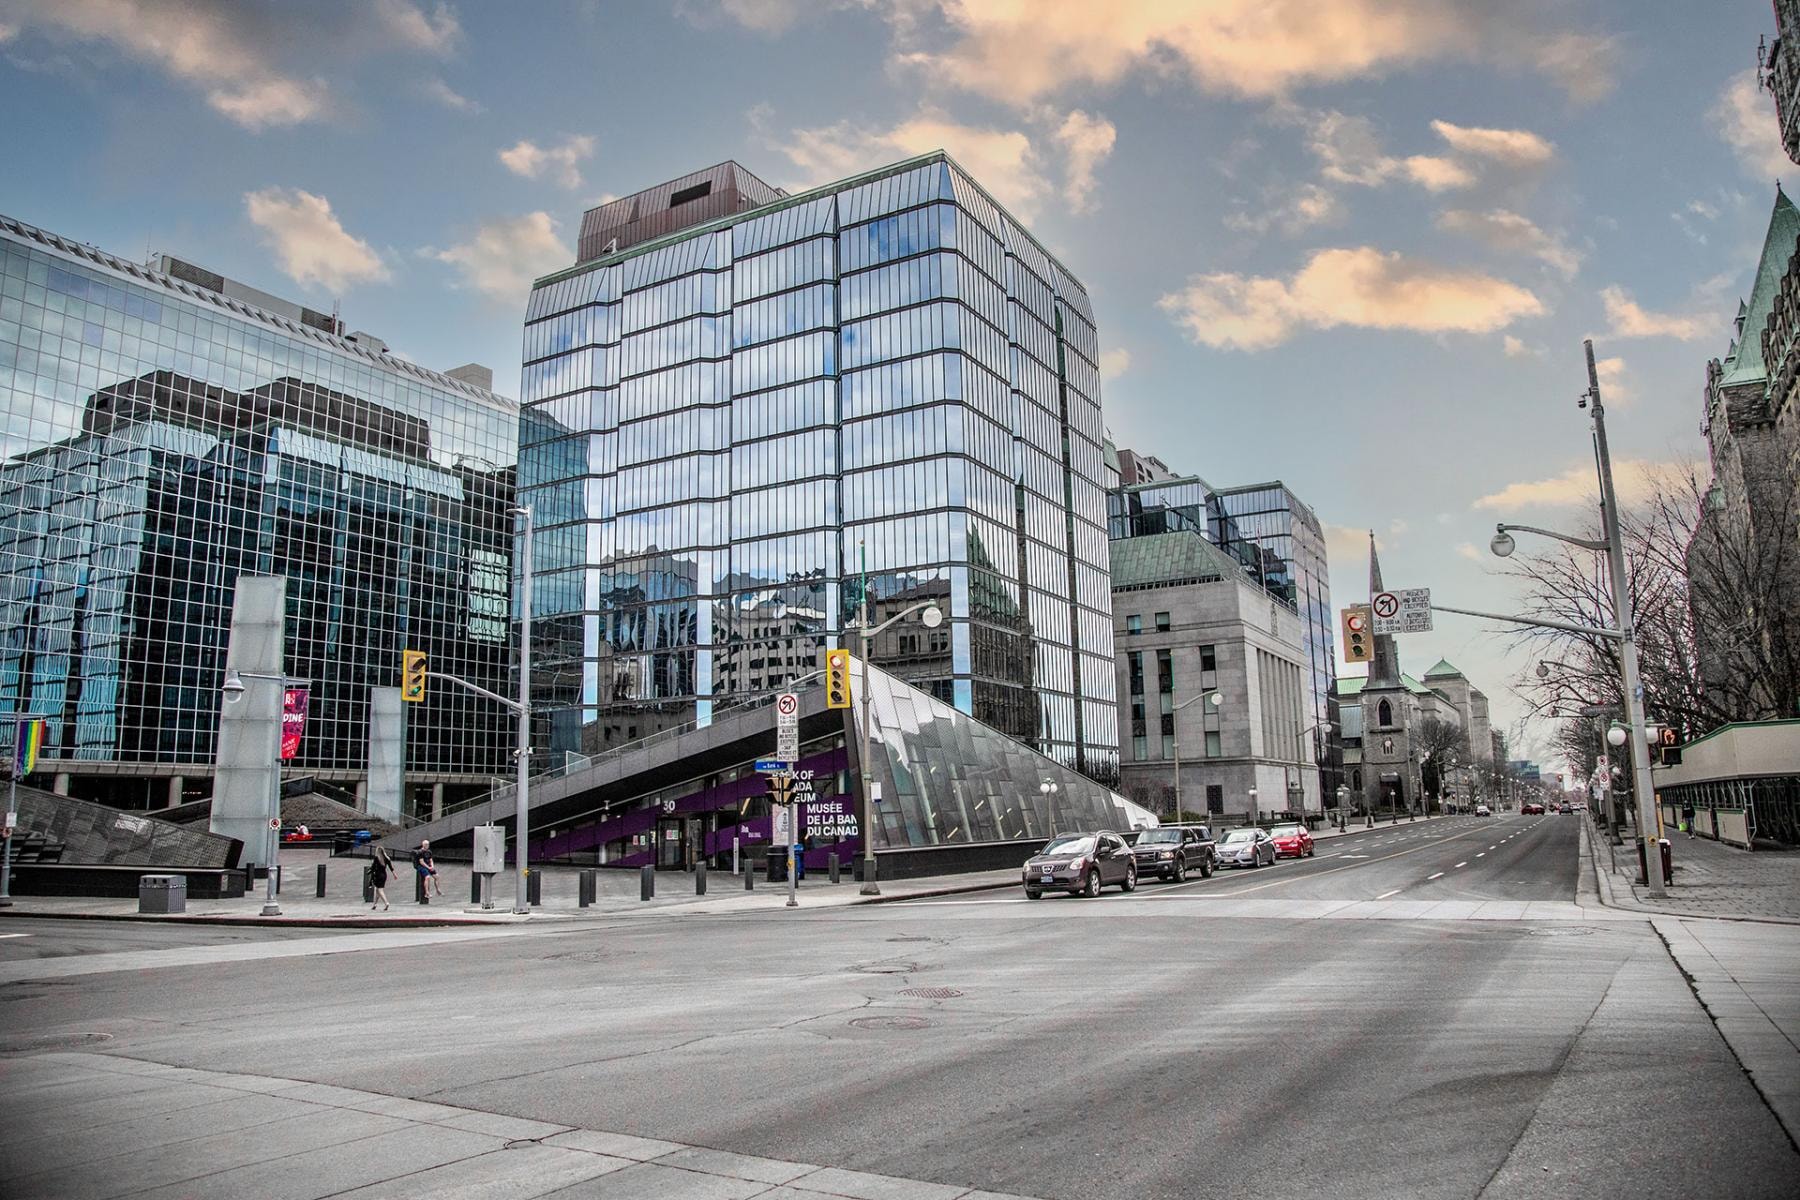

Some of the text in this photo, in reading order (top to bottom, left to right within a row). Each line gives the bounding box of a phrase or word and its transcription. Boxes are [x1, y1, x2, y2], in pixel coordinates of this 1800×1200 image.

[283, 714, 304, 722] DINE
[800, 770, 814, 780] OF
[794, 781, 812, 791] ADA
[794, 793, 816, 802] EUM
[663, 800, 675, 810] 30
[807, 801, 842, 813] MUSÉE
[807, 815, 857, 824] DE LA BAN
[808, 826, 858, 836] DU CANAD
